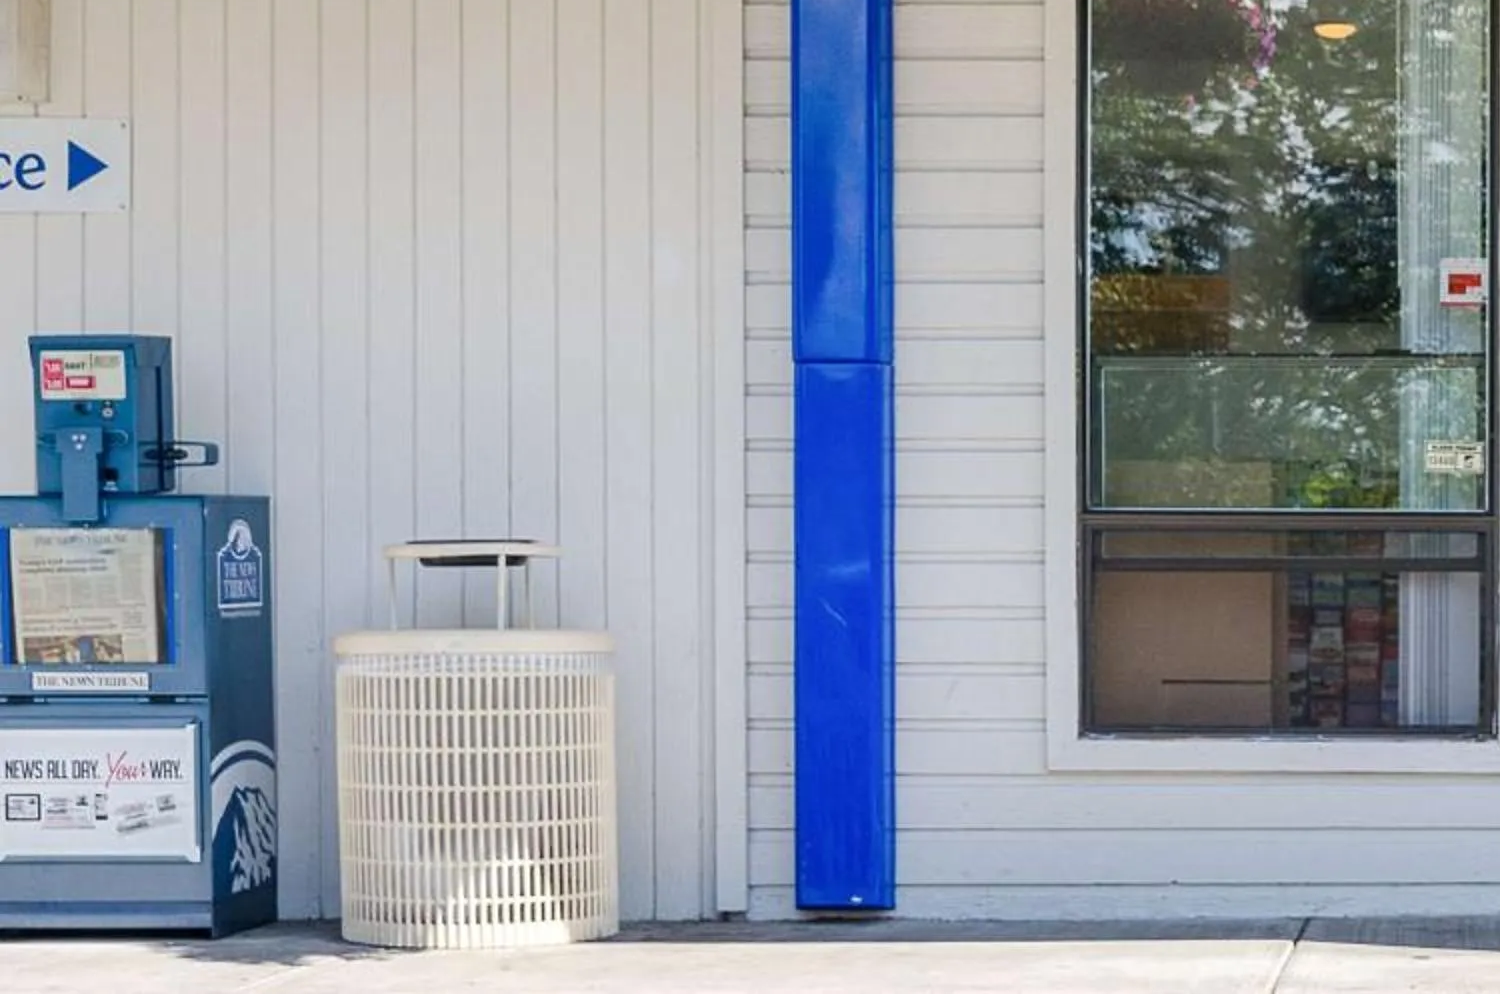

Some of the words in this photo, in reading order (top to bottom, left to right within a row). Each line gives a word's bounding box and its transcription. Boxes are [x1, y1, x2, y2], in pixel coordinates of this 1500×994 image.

[5, 759, 43, 779] NEWS
[47, 759, 68, 779] ALL
[71, 759, 101, 779] DAY.
[149, 759, 183, 779] WAY.
